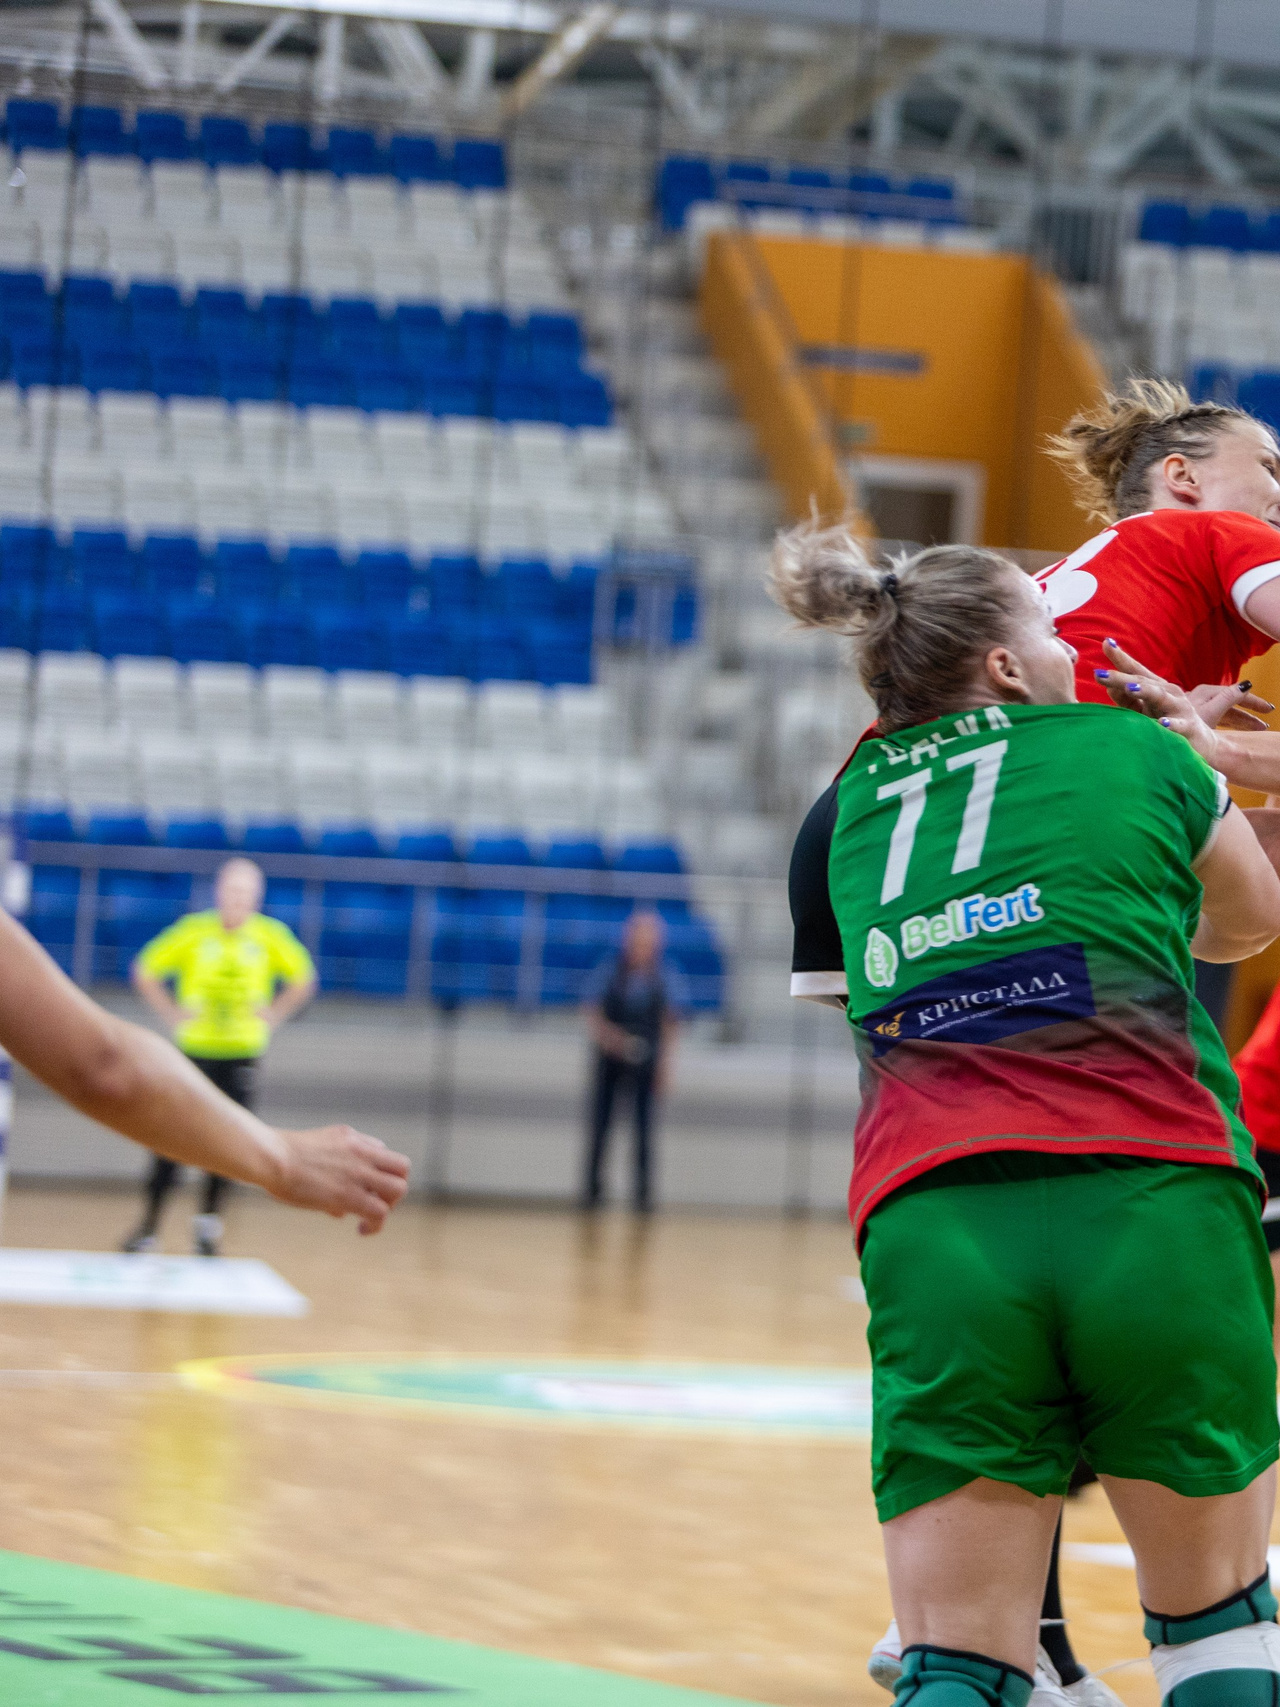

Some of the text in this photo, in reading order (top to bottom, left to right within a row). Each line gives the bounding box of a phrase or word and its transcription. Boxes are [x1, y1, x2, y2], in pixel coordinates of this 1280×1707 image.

[877, 740, 1008, 905] 77
[902, 884, 1043, 959] BelFert
[917, 972, 1068, 1026] КРИСТАЛЛ
